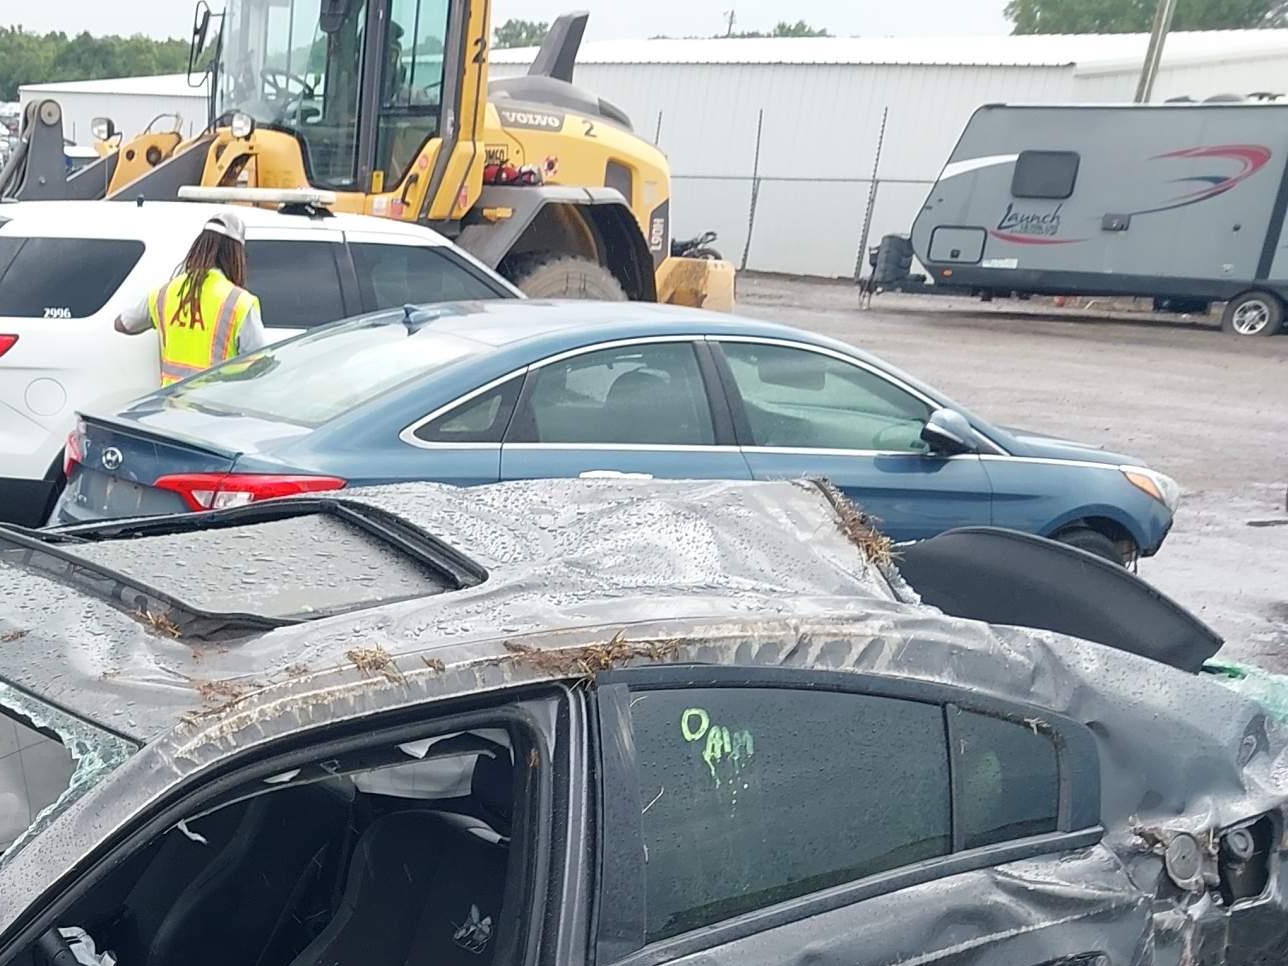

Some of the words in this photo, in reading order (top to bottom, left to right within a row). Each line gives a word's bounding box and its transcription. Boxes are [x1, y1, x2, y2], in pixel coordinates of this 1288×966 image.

[472, 37, 487, 64] 2
[502, 110, 560, 128] VOLVO
[581, 119, 597, 138] 2
[997, 202, 1062, 235] Launch
[650, 218, 665, 251] L90H
[43, 307, 72, 319] 2996
